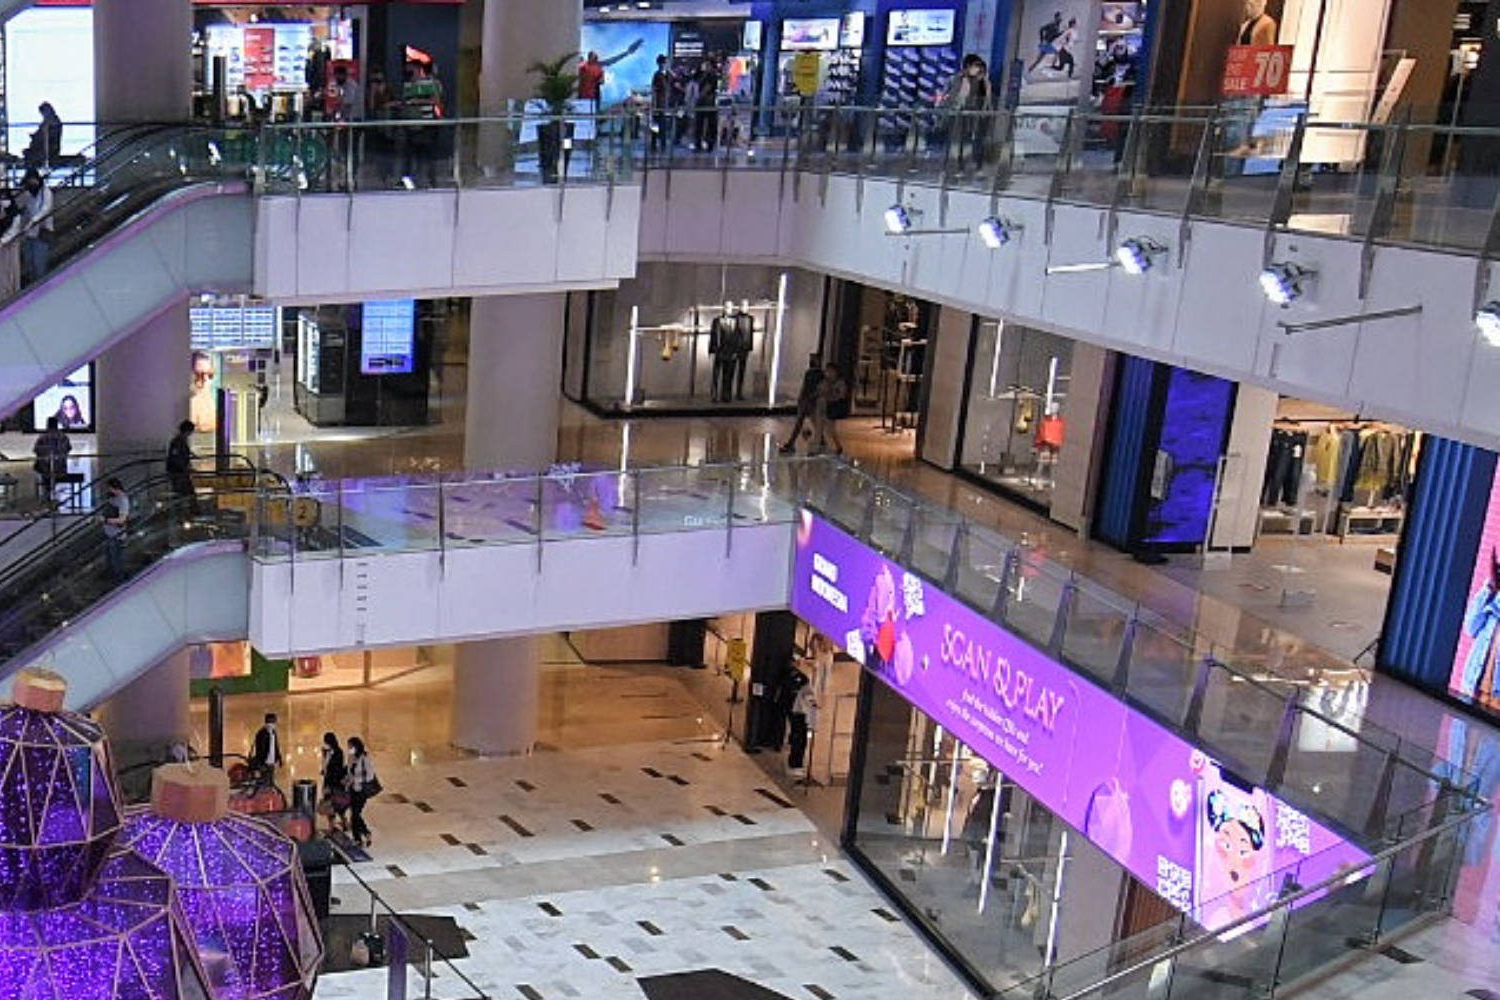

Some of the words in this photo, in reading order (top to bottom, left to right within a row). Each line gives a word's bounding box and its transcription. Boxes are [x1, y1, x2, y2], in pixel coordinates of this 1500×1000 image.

[1252, 51, 1285, 88] 70
[940, 624, 992, 681] SCAN
[993, 657, 1014, 708] &
[1013, 670, 1065, 731] PLAY
